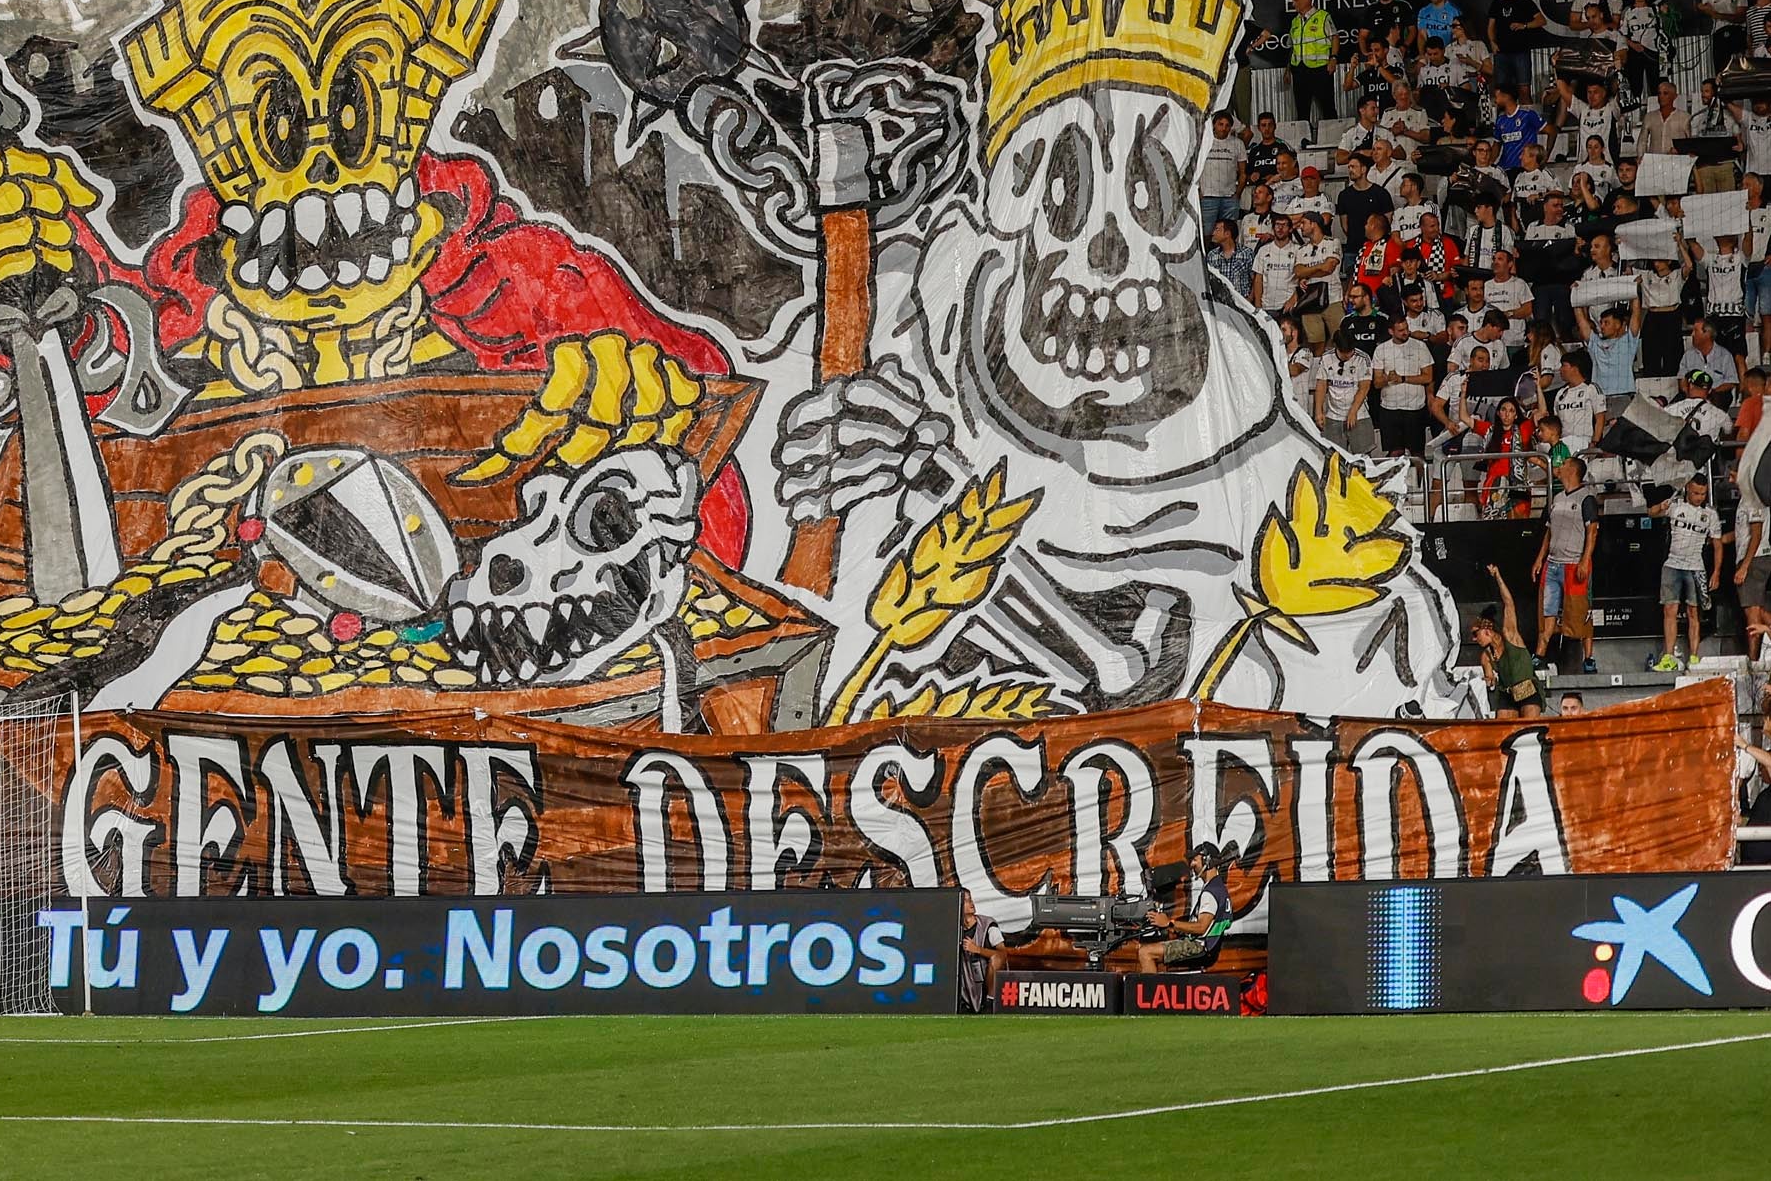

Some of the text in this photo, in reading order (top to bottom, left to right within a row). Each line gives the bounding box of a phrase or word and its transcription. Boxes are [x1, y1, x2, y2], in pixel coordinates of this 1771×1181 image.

[1368, 82, 1389, 92] DIGI
[1254, 158, 1277, 168] DIGI
[1354, 332, 1375, 341] IGI
[1558, 400, 1583, 411] DIGI
[1674, 520, 1708, 533] DIGI
[60, 728, 556, 899] GENTE
[620, 726, 1573, 936] DESCREIDA
[39, 905, 935, 1013] Tú y yo. Nosotros.
[1001, 980, 1106, 1009] #FANCAM
[1136, 983, 1230, 1011] LALIGA
